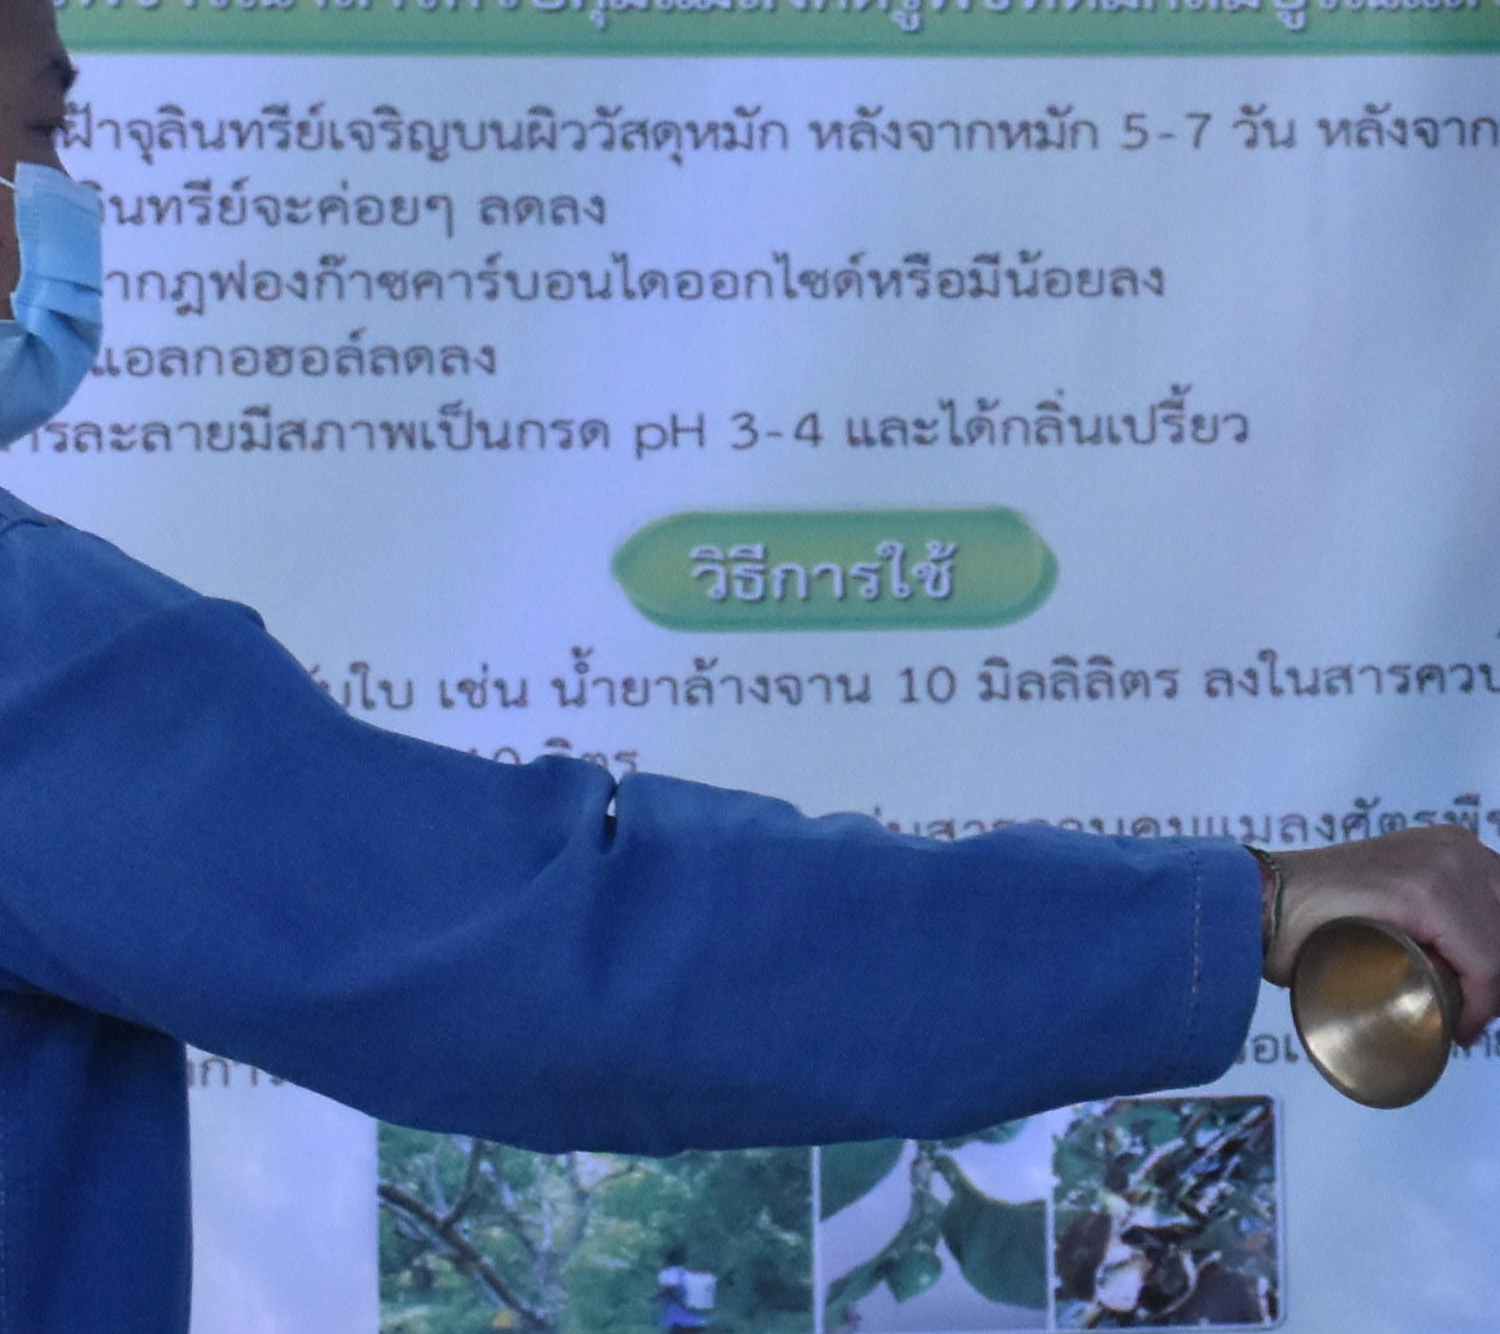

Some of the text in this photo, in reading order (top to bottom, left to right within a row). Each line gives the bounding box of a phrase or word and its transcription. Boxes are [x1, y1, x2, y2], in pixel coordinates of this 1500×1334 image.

[807, 103, 1100, 153] หลังจากหมัก
[1120, 111, 1214, 152] 5-7
[1231, 102, 1297, 150] วัน
[478, 193, 607, 227] ลดลง
[634, 412, 706, 461] pH
[730, 410, 824, 451] 3-4
[845, 382, 1251, 450] และได้กลิ่นเปรี้ยว
[690, 539, 957, 604] วิธีการใช้
[438, 661, 530, 711] เช่น
[549, 644, 873, 709] น้ำยาล้างจาน
[899, 664, 958, 705] 10
[976, 653, 1181, 703] มิลลิลิตร
